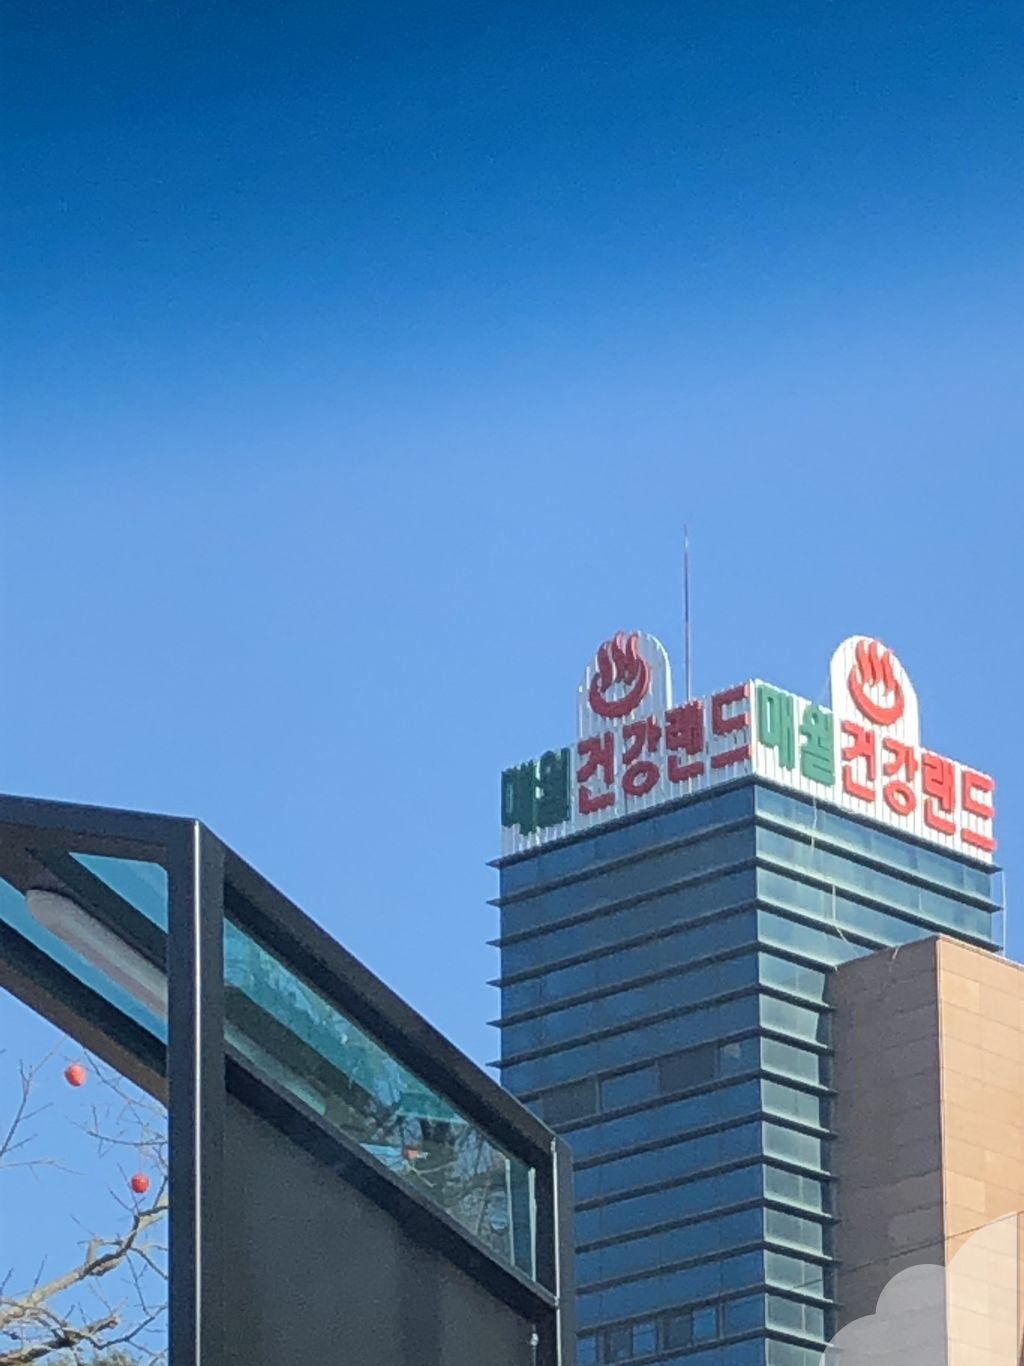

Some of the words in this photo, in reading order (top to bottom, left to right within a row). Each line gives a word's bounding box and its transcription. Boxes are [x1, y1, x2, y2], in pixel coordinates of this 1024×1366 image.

[576, 684, 750, 815] 건강랜드
[757, 684, 836, 786] 매월
[841, 719, 997, 852] 건강랜드
